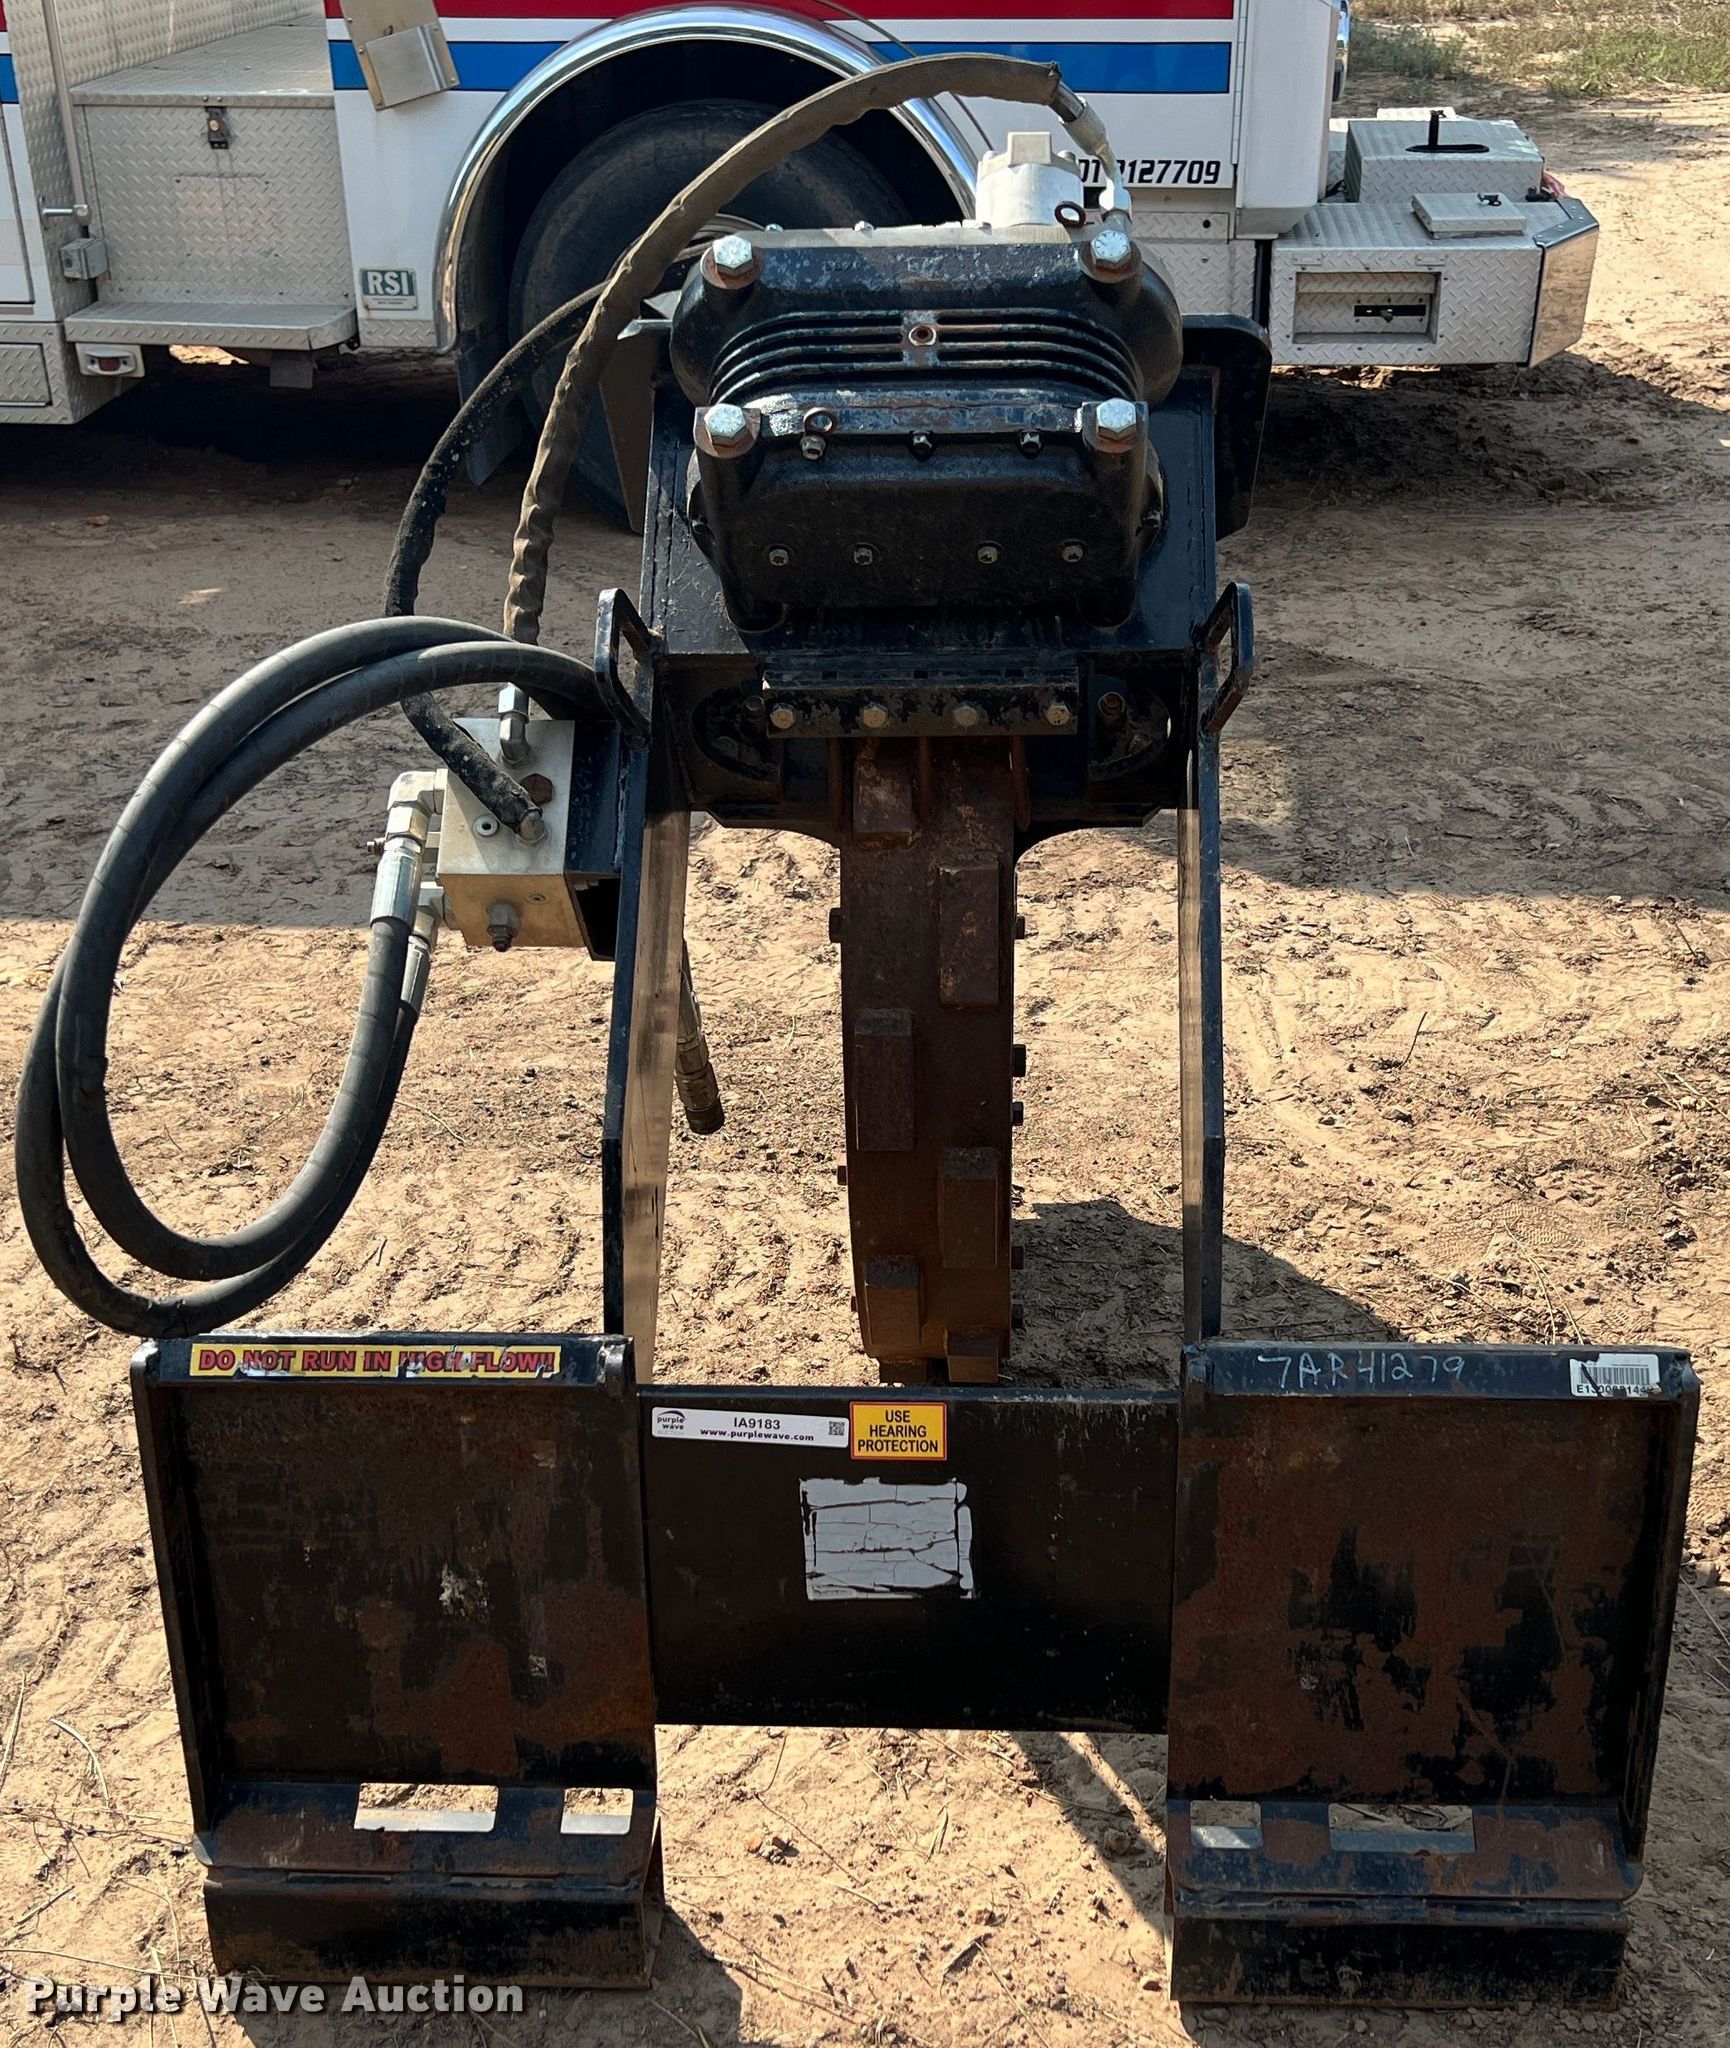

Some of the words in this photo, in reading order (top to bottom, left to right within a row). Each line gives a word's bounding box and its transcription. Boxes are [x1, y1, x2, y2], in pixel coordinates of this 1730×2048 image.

[367, 271, 409, 295] RSI
[199, 1350, 236, 1371] DO
[242, 1350, 297, 1371] NOT
[301, 1351, 357, 1372] RUN
[363, 1351, 392, 1372] IN
[657, 1416, 685, 1424] purple
[885, 1410, 911, 1423] USE
[733, 1417, 781, 1430] IA9183
[700, 1429, 814, 1441] www.purplewave.com
[869, 1425, 927, 1438] HEARING
[857, 1440, 939, 1453] PROTECTION
